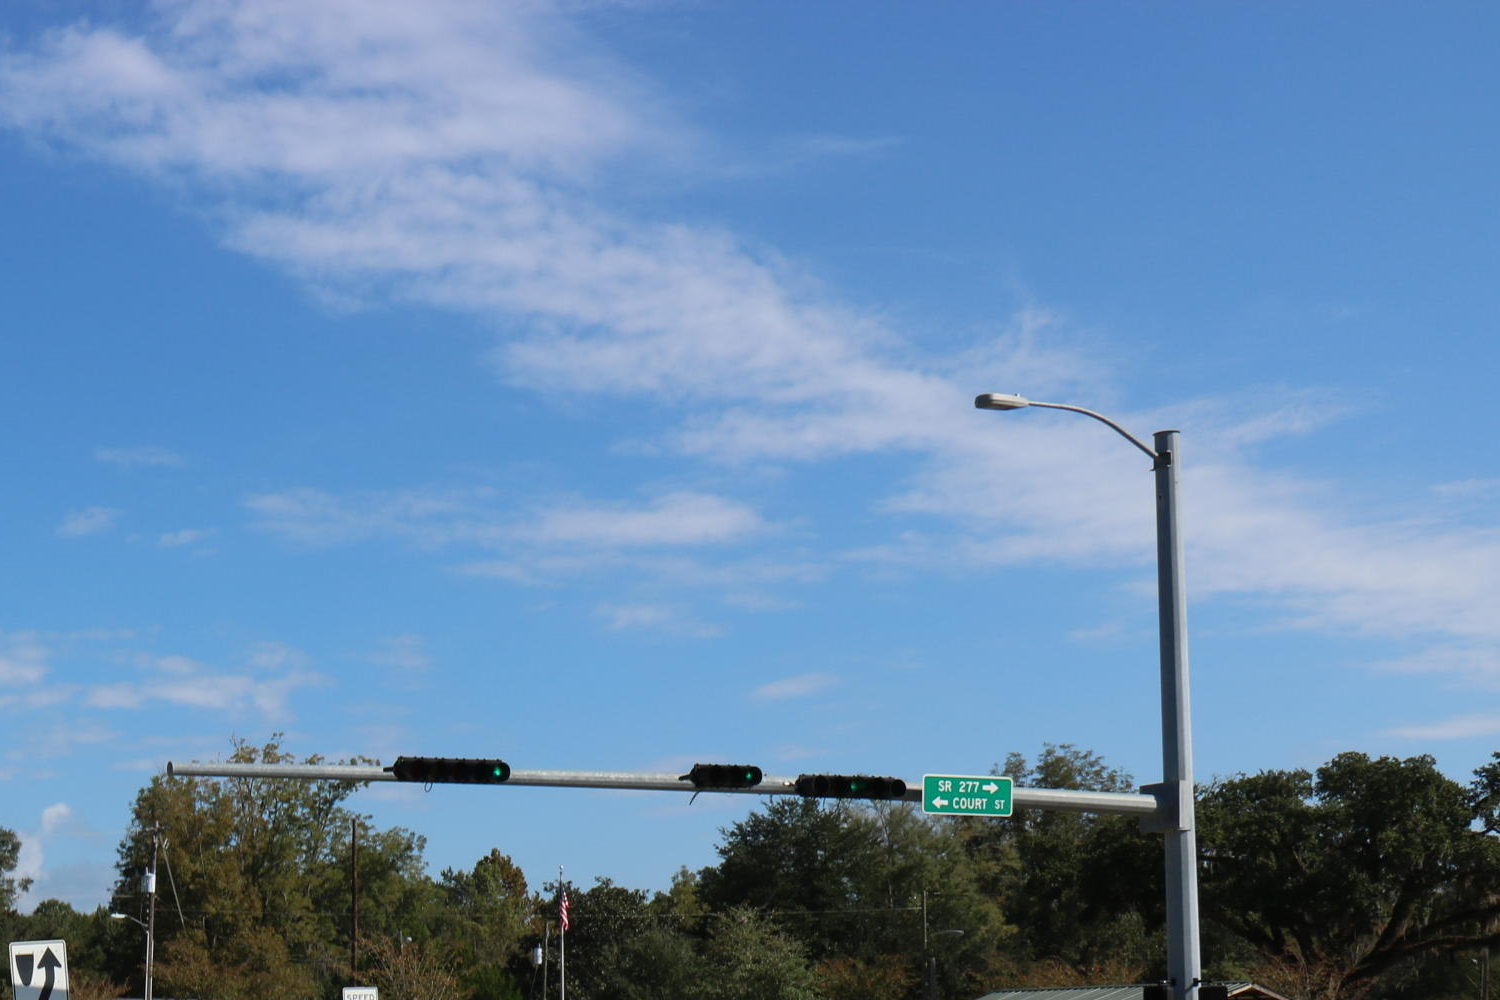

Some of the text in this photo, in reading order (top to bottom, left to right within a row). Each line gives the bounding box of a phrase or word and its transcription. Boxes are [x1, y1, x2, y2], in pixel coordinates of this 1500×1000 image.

[938, 780, 980, 793] SR 277
[952, 797, 1005, 810] COURT ST
